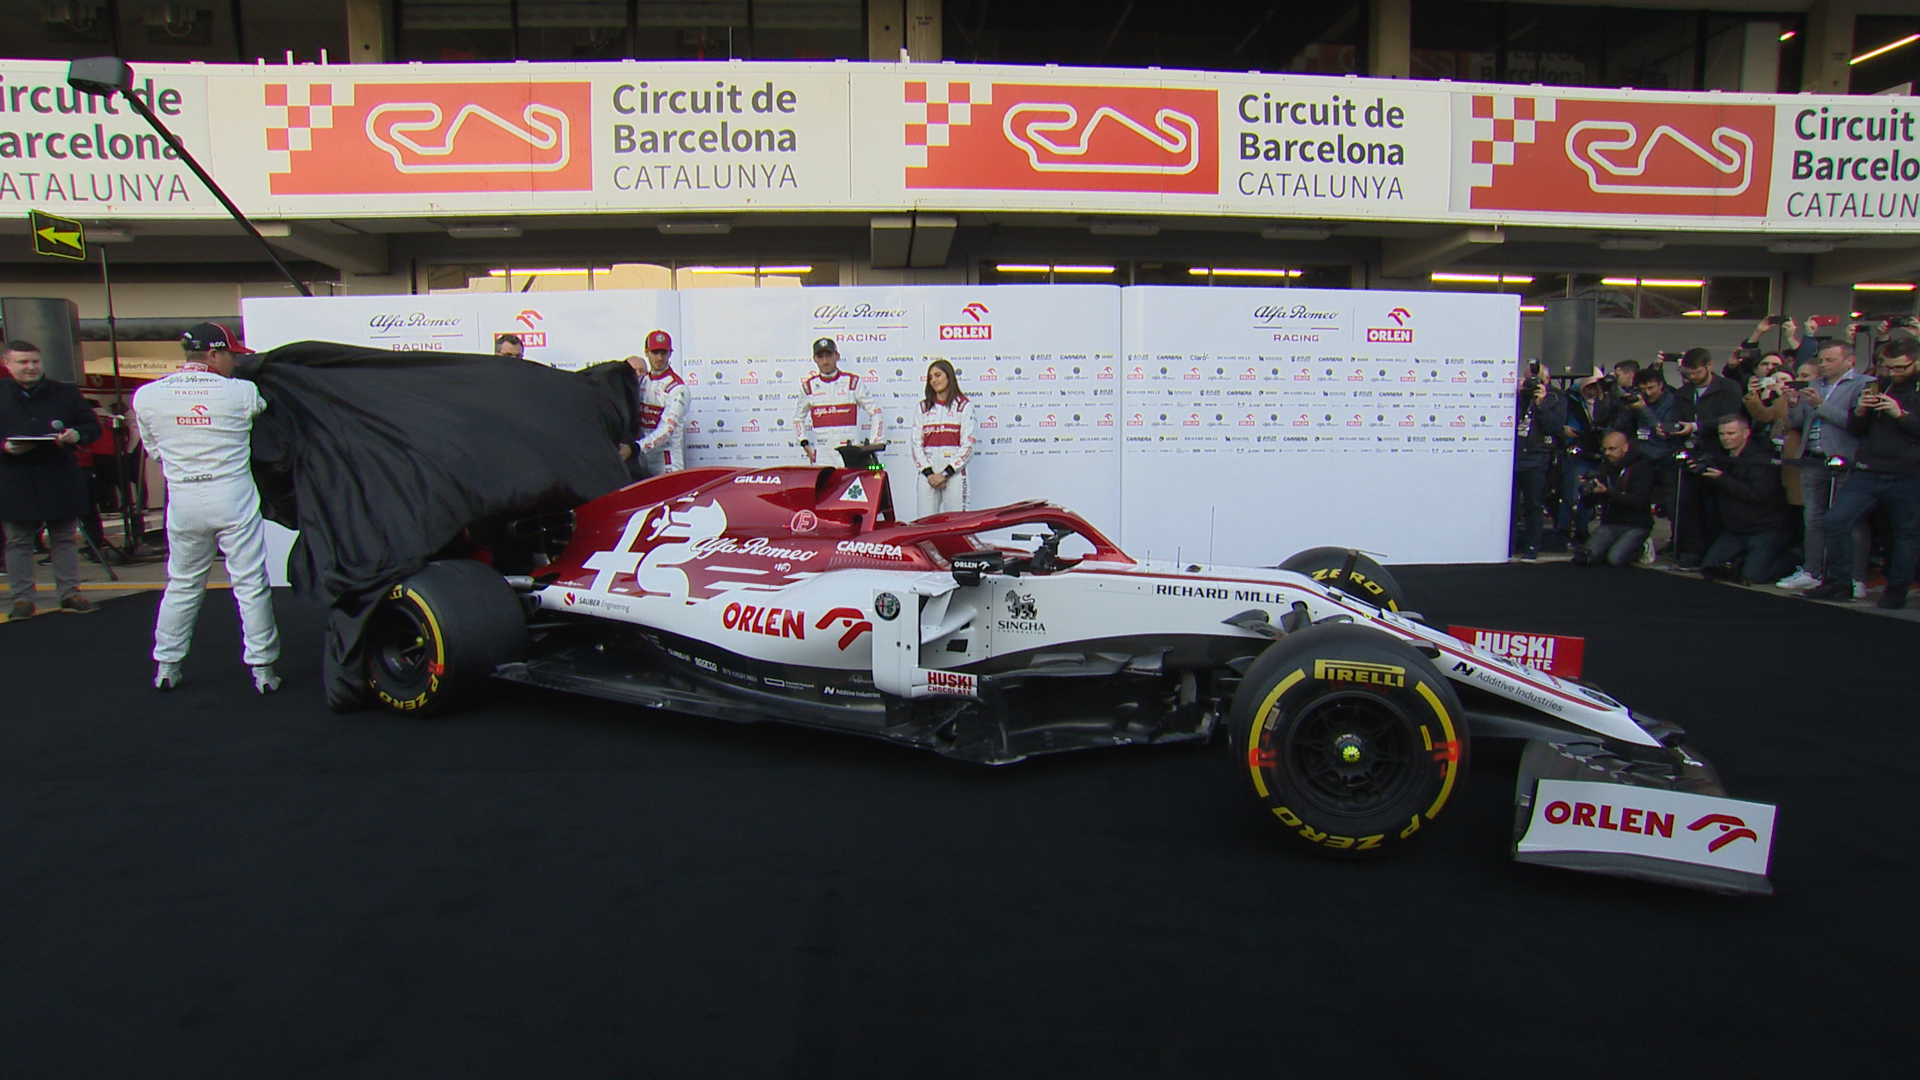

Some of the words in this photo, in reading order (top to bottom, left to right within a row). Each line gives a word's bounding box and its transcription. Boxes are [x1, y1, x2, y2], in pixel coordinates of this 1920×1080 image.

[130, 78, 182, 115] de
[613, 81, 742, 114] Circuit
[751, 82, 796, 113] de
[1238, 92, 1356, 127] Circuit
[1364, 98, 1404, 128] de
[614, 121, 796, 153] Barcelona
[1794, 107, 1914, 141] Circuit
[0, 124, 183, 160] arcelona
[1240, 133, 1404, 165] Barcelona
[613, 164, 797, 190] CATALUNYA
[1792, 149, 1920, 181] Barcelo
[0, 173, 190, 201] ATALUNYA
[1238, 172, 1404, 200] CATALUNYA
[1787, 192, 1919, 218] CATALUN
[369, 312, 406, 333] Alfa
[407, 312, 462, 327] Romeo
[814, 305, 851, 324] Alfa
[853, 304, 907, 318] Romeo
[1254, 305, 1289, 323] Alfa
[1290, 305, 1339, 320] Romeo
[837, 333, 887, 342] RACING
[942, 327, 989, 339] ORLEN
[1274, 334, 1320, 342] RACING
[1369, 330, 1410, 341] ORLEN
[392, 342, 442, 352] RACING
[734, 476, 781, 484] GIULIA
[690, 537, 742, 560] Alfa
[742, 537, 818, 561] Romeo
[837, 541, 902, 556] CARRERA
[1156, 584, 1229, 600] RICHARD
[1234, 590, 1285, 604] MILLE
[1312, 568, 1384, 595] ZERO
[579, 598, 600, 607] SAUBER
[722, 602, 805, 640] ORLEN
[998, 620, 1046, 632] SINGHA
[1475, 631, 1554, 659] HUSKI
[928, 671, 972, 689] HUSKI
[1314, 659, 1406, 687] PIRELLI
[380, 691, 428, 710] ZERO
[928, 686, 972, 696] CHOCOLATE
[1476, 672, 1515, 693] Additive
[1516, 687, 1564, 712] Industries
[1272, 806, 1385, 850] ZERO
[1400, 814, 1420, 839] P
[1544, 800, 1675, 838] ORLEN
